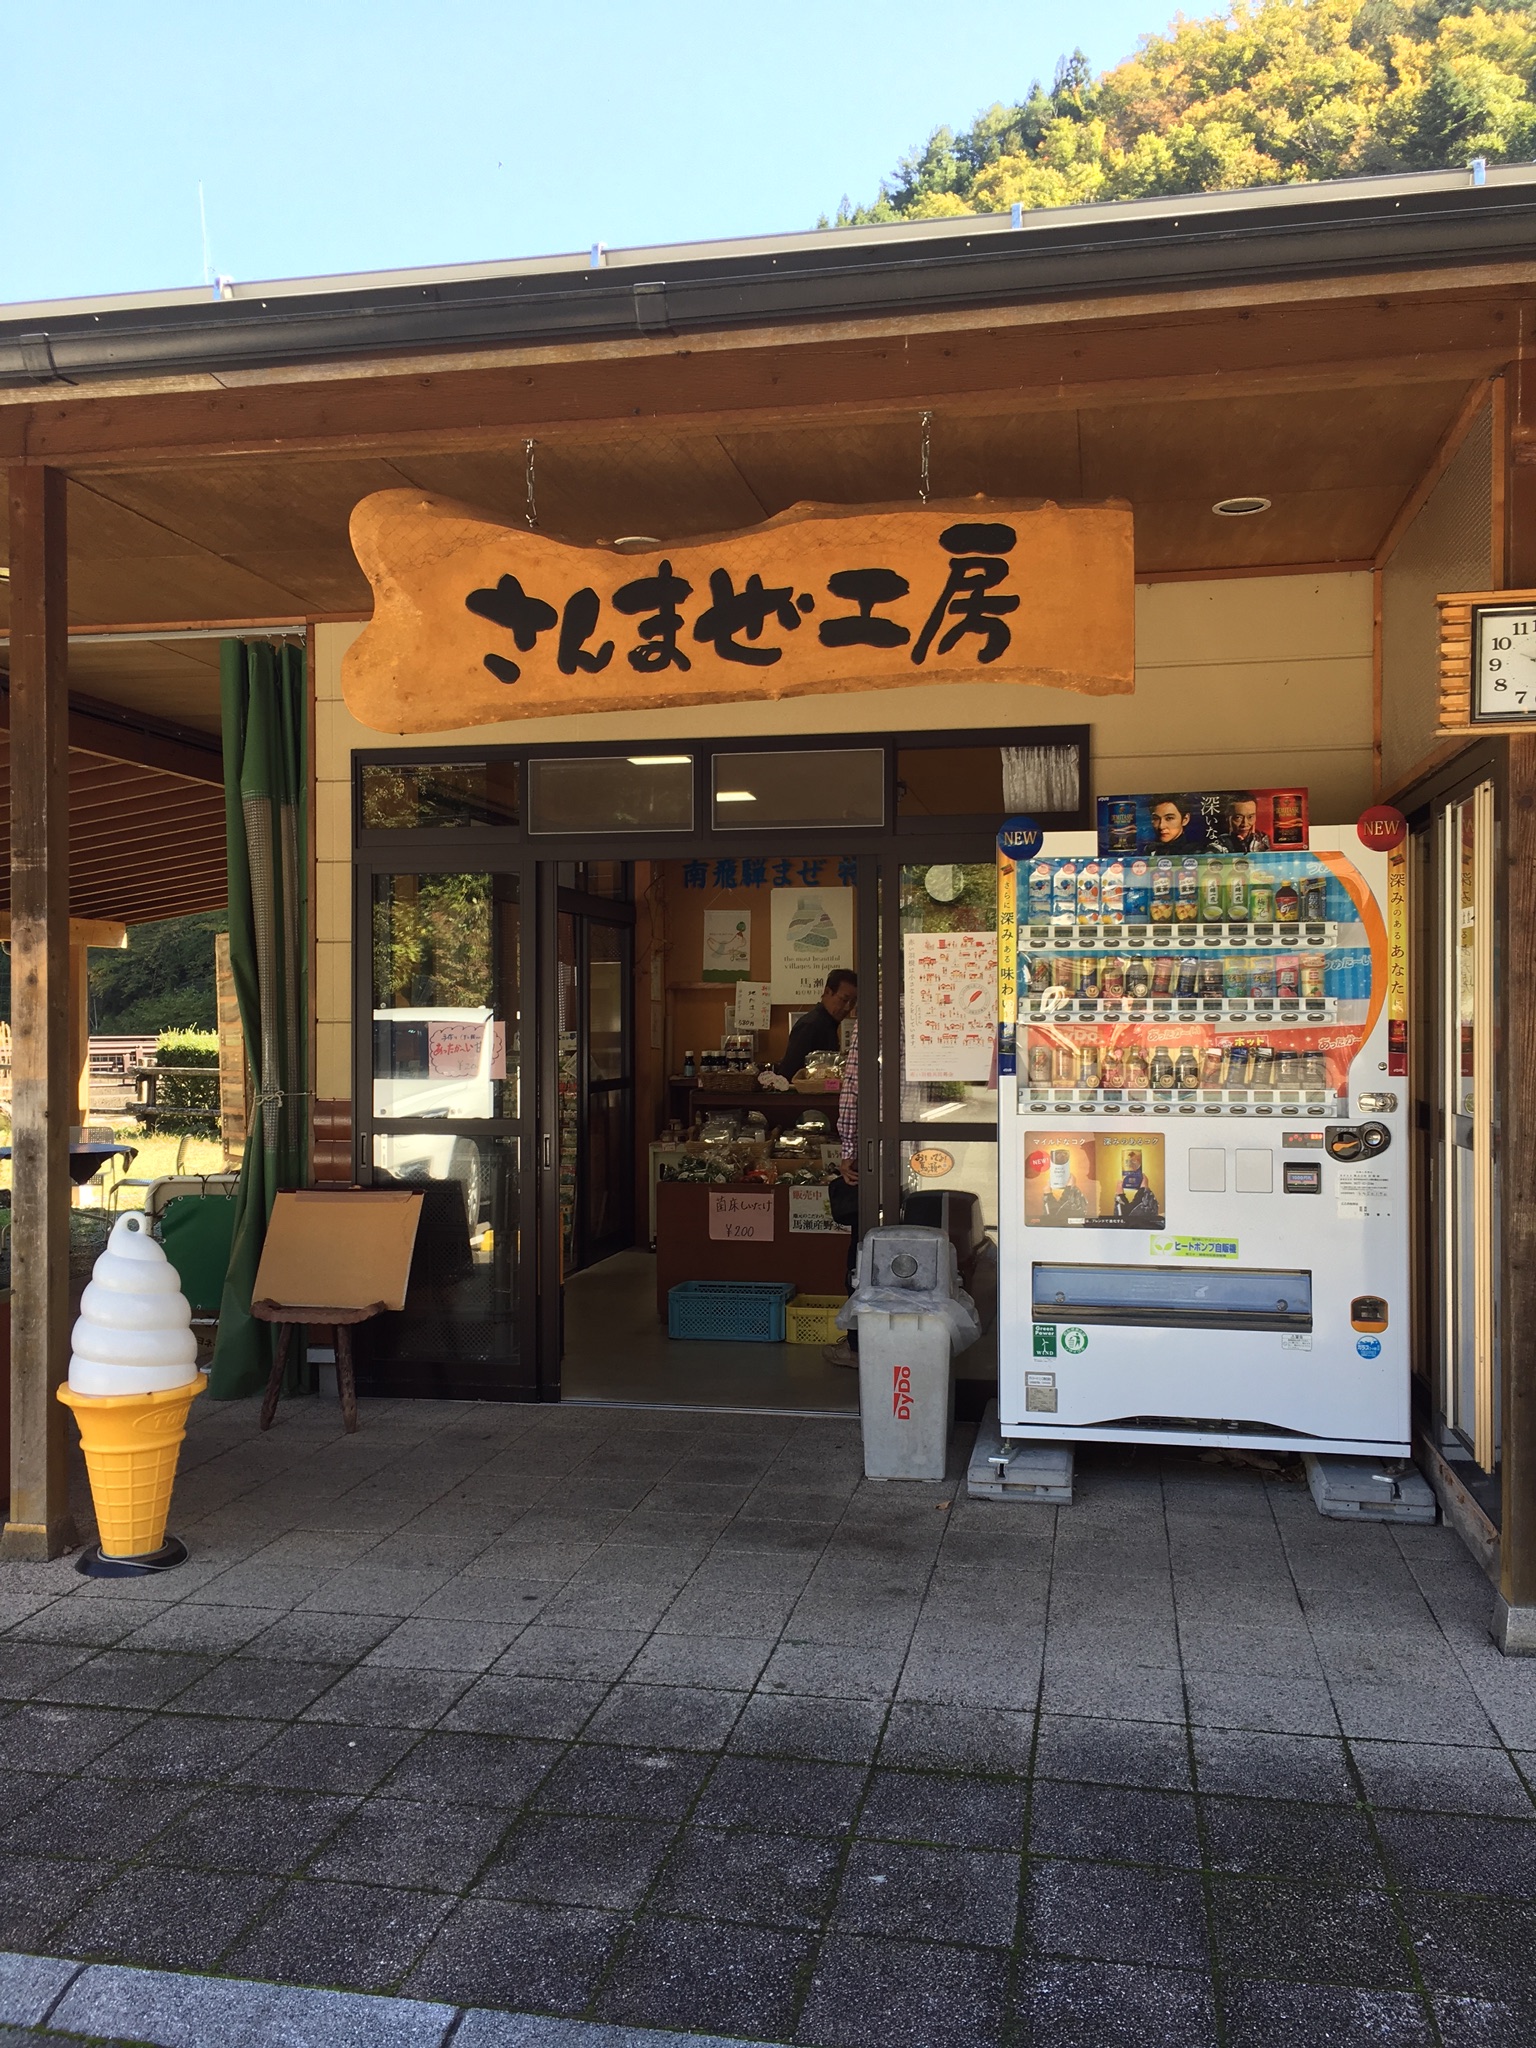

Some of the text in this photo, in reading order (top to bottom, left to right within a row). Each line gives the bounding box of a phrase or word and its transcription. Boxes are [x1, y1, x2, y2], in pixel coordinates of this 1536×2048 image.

[465, 522, 1021, 685] さんまぜ工房
[1513, 622, 1528, 635] 11
[1492, 637, 1512, 651] 10
[1489, 658, 1502, 672] 9
[1494, 678, 1507, 691] 8
[1515, 691, 1527, 704] 7
[1363, 820, 1400, 836] NEW
[1003, 831, 1038, 846] NEW
[1175, 1242, 1236, 1254] ヒートポンプ自販機
